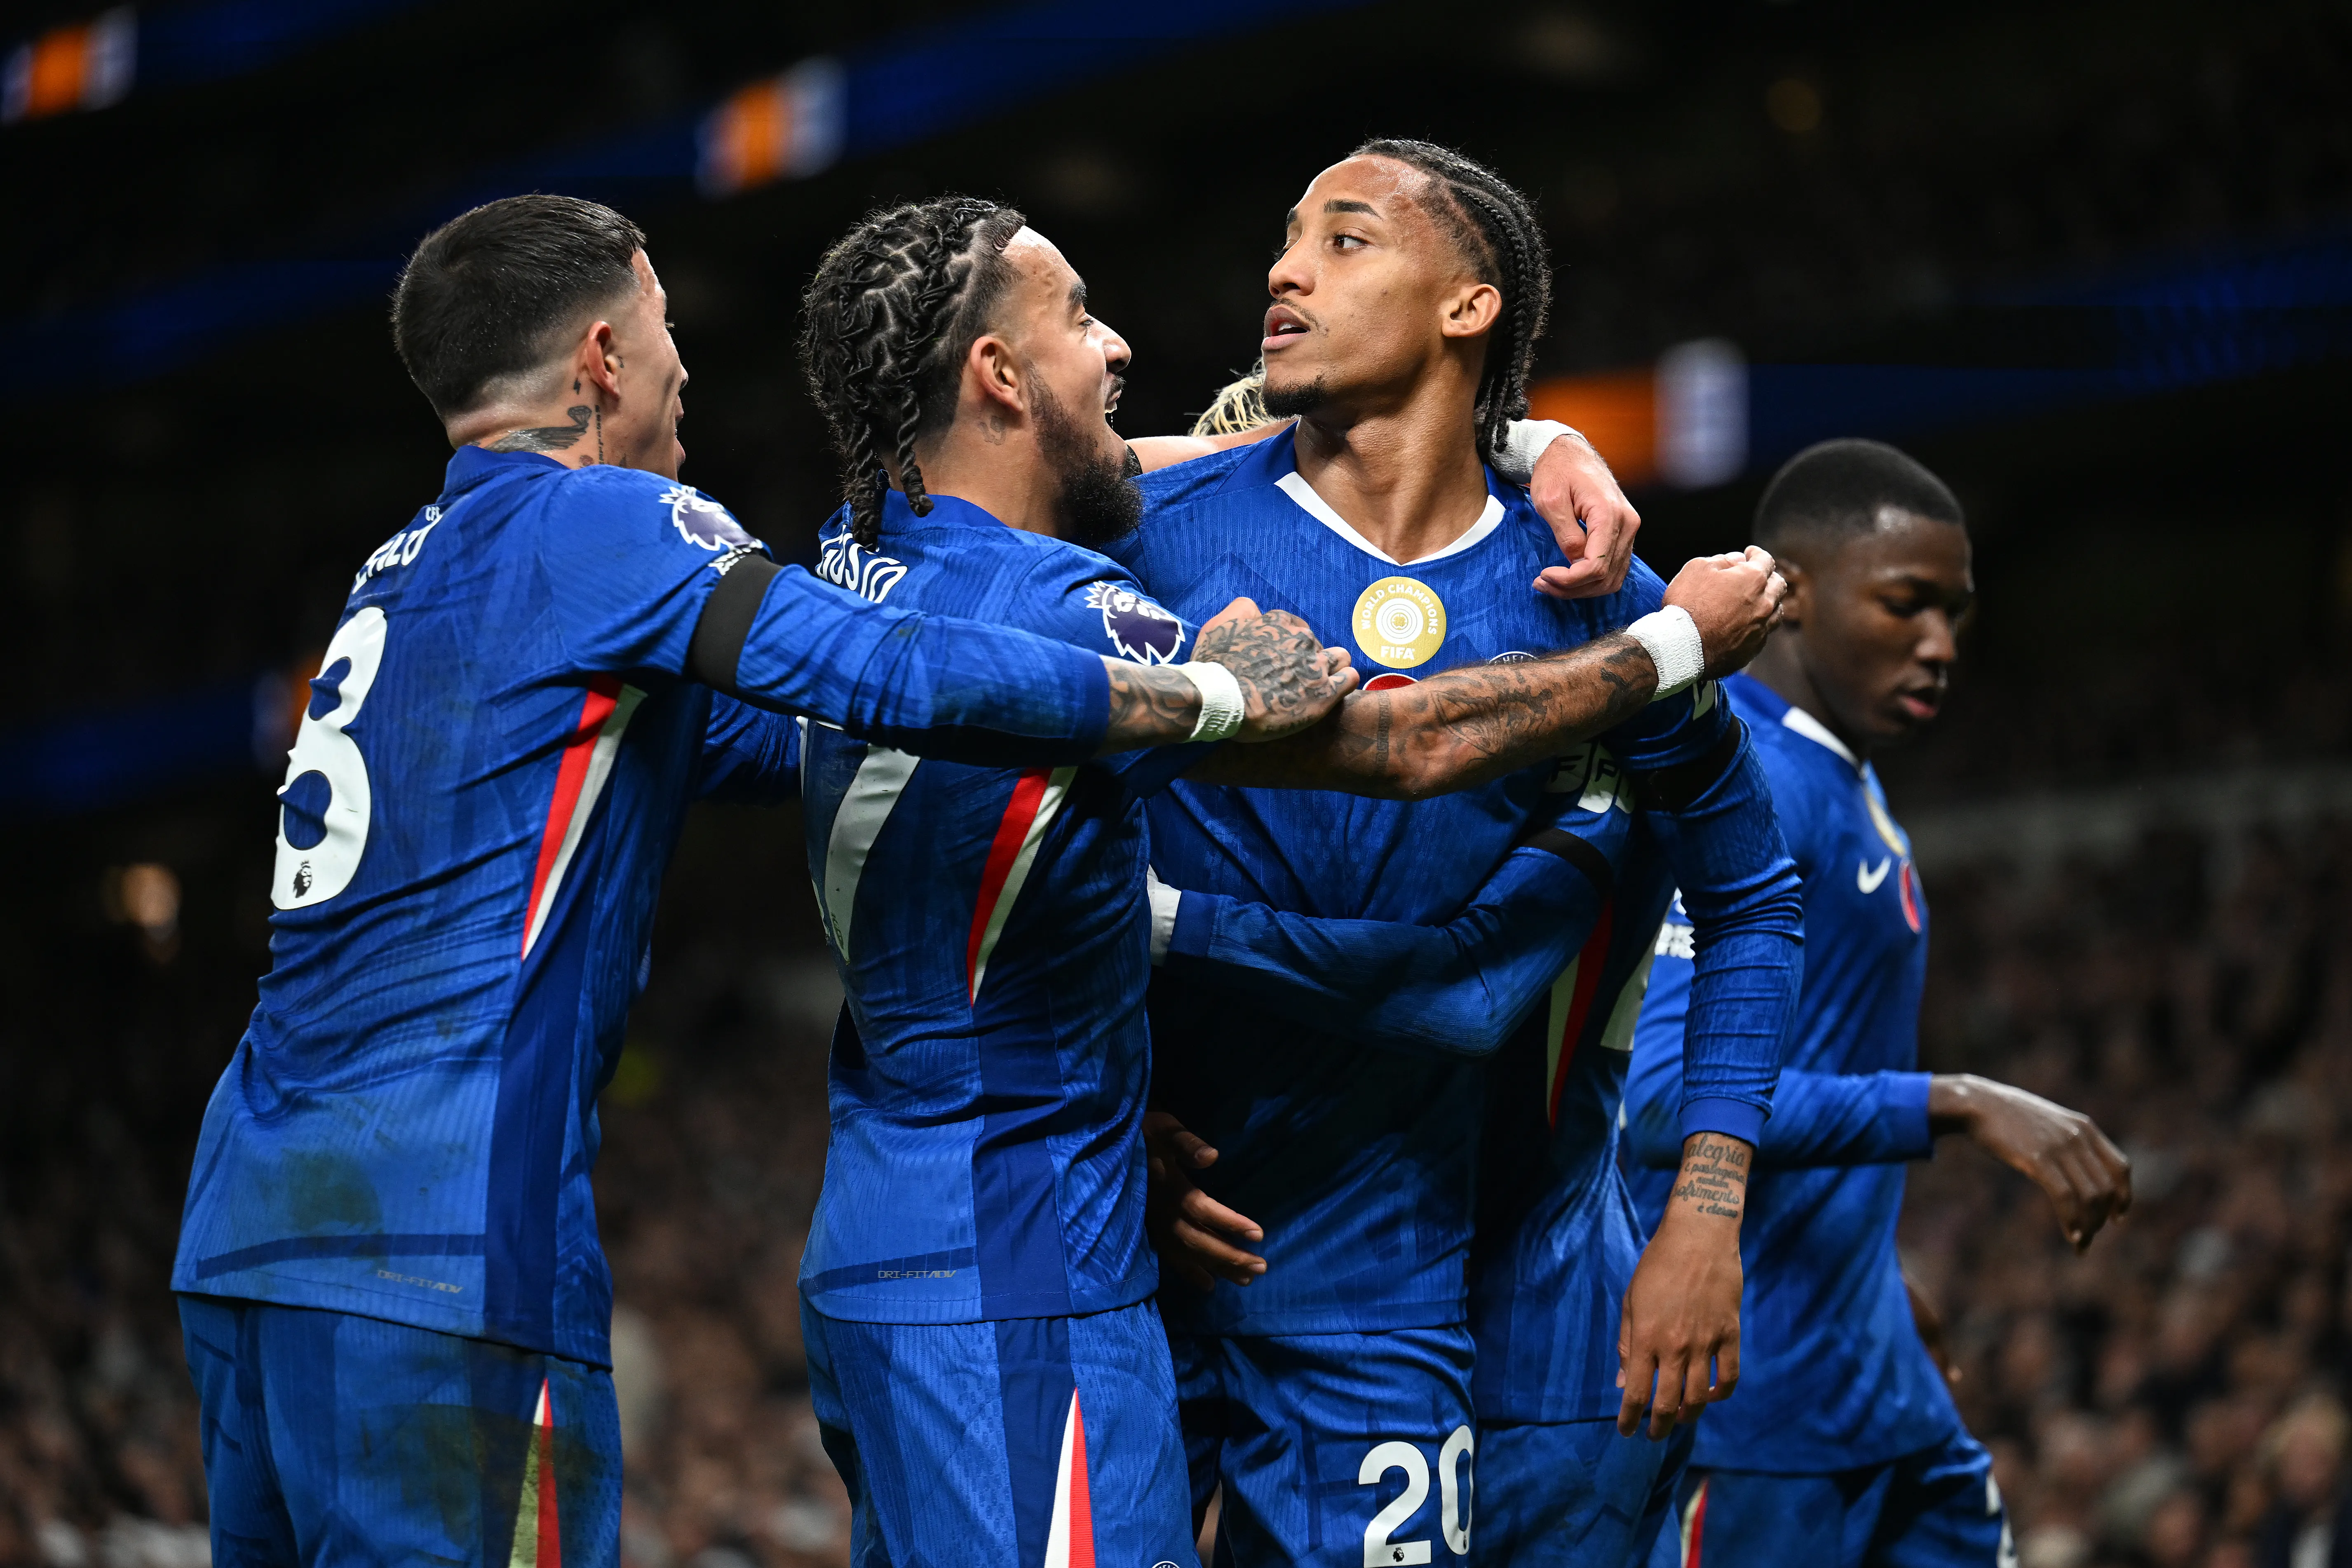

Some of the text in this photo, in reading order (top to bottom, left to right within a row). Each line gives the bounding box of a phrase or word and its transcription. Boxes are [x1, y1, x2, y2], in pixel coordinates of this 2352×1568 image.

[1361, 584, 1438, 635] WORLD CHAMPIONS
[1380, 645, 1415, 660] FIFA
[270, 606, 387, 910] 8
[1358, 1425, 1474, 1568] 20
